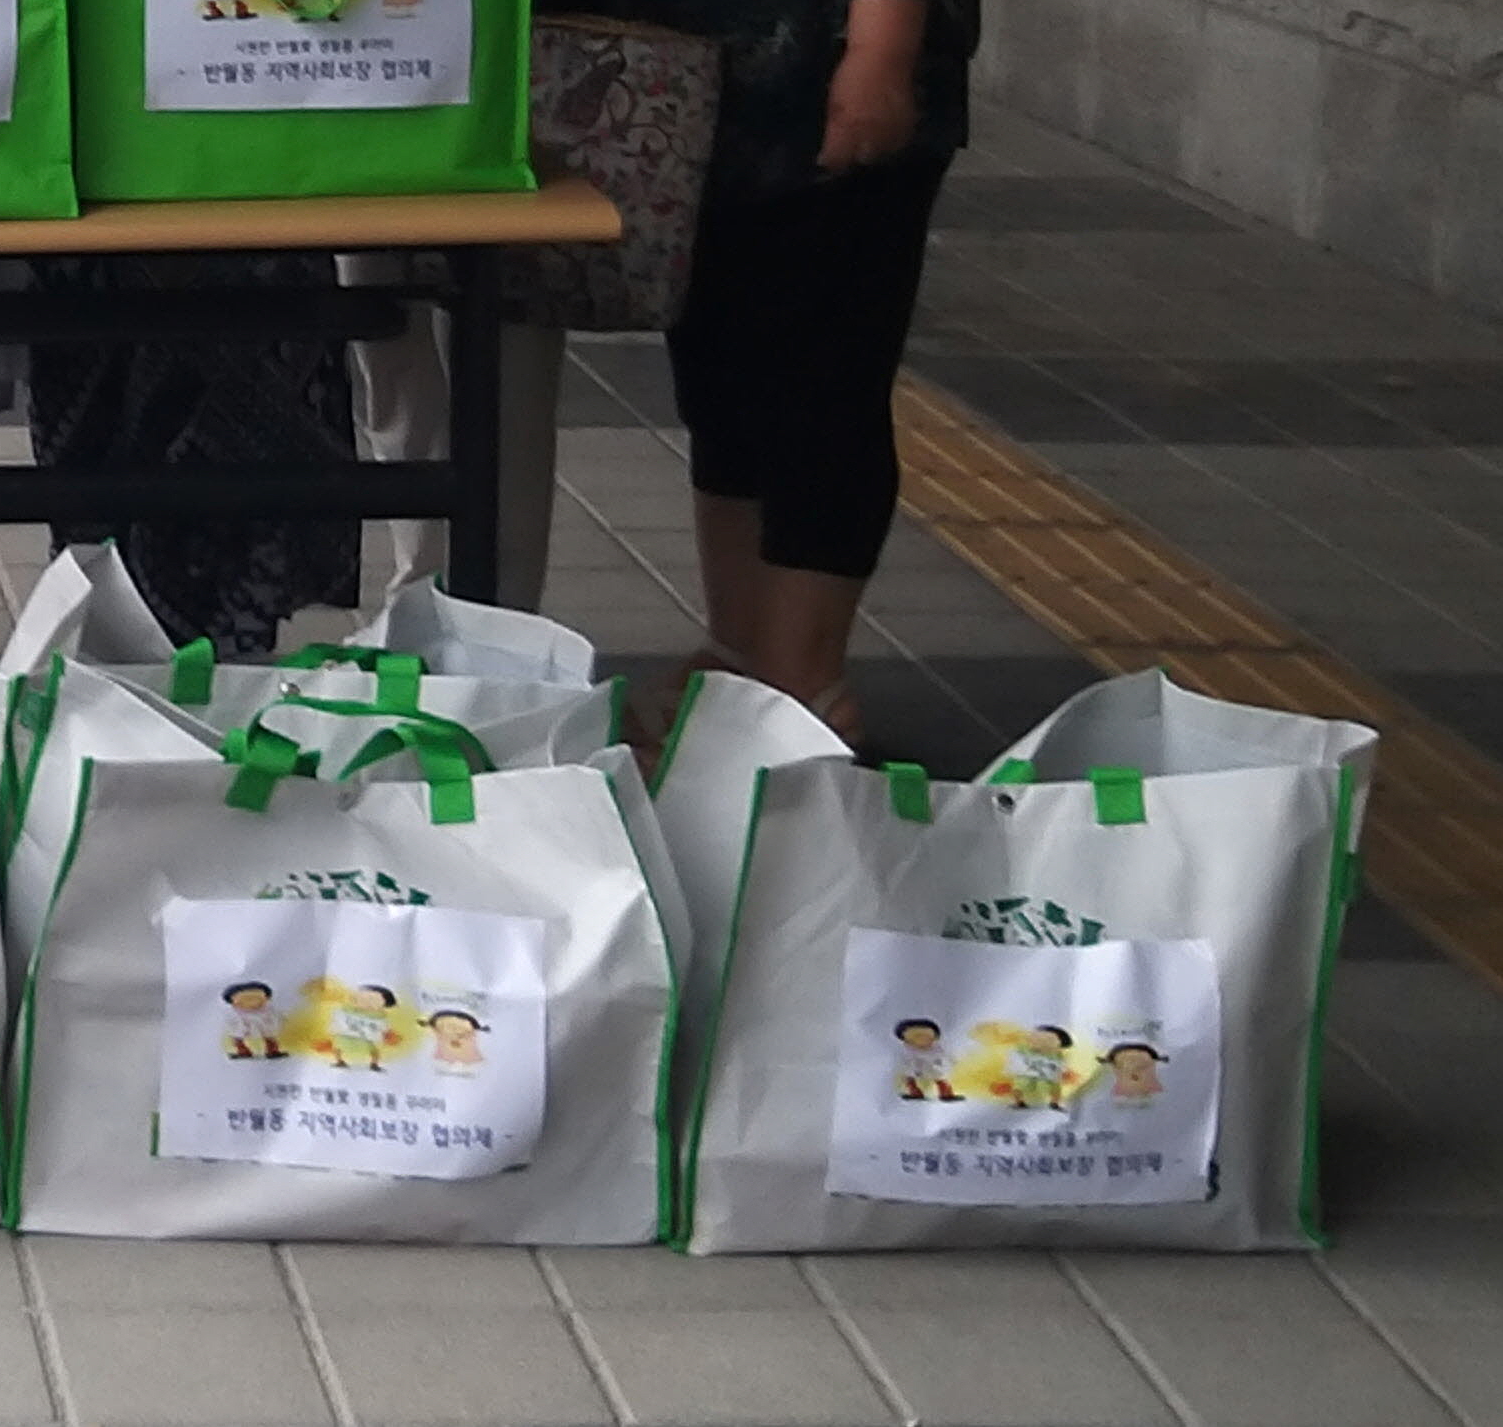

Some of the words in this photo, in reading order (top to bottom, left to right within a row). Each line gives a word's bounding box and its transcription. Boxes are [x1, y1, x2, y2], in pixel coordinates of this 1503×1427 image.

[203, 63, 256, 85] 반월동
[381, 59, 433, 81] 협의체
[227, 1106, 287, 1134] 반월동
[297, 1109, 418, 1146] 지역사회보장
